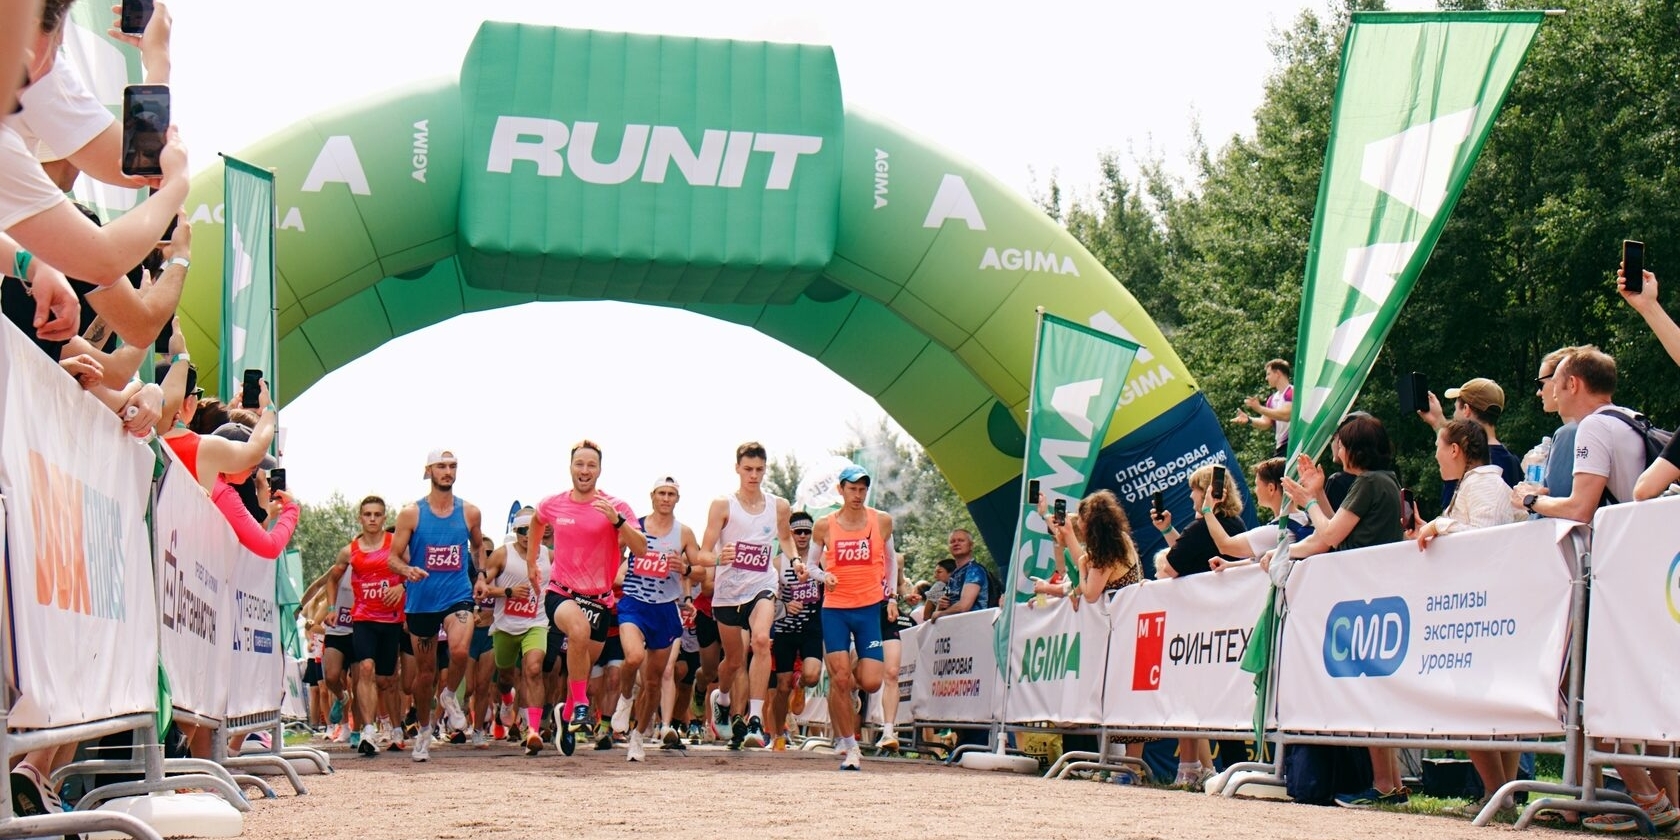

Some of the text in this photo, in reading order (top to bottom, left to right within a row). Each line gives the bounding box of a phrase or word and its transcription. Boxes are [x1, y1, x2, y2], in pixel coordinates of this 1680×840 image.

[411, 119, 429, 183] AGIMA
[486, 115, 823, 190] RUNIT
[874, 148, 889, 210] AGIMA
[979, 247, 1080, 277] AGIMA
[1115, 363, 1176, 412] GIMA
[1126, 456, 1157, 479] ПСБ
[1133, 444, 1210, 491] ЦИФРОВАЯ
[427, 554, 460, 566] 5543
[636, 557, 668, 573] 7012
[735, 551, 768, 567] 5063
[838, 548, 870, 561] 7038
[362, 588, 388, 600] 701
[793, 586, 818, 600] 5858
[1426, 590, 1487, 612] анализы
[507, 600, 537, 614] 7043
[1331, 612, 1402, 662] CMD
[1423, 617, 1516, 644] экспертного
[1018, 632, 1081, 683] AGIMA
[1169, 627, 1254, 666] ФИНТЕХ
[938, 657, 973, 678] ЦИФРОВАЯ
[1418, 650, 1472, 674] уровня
